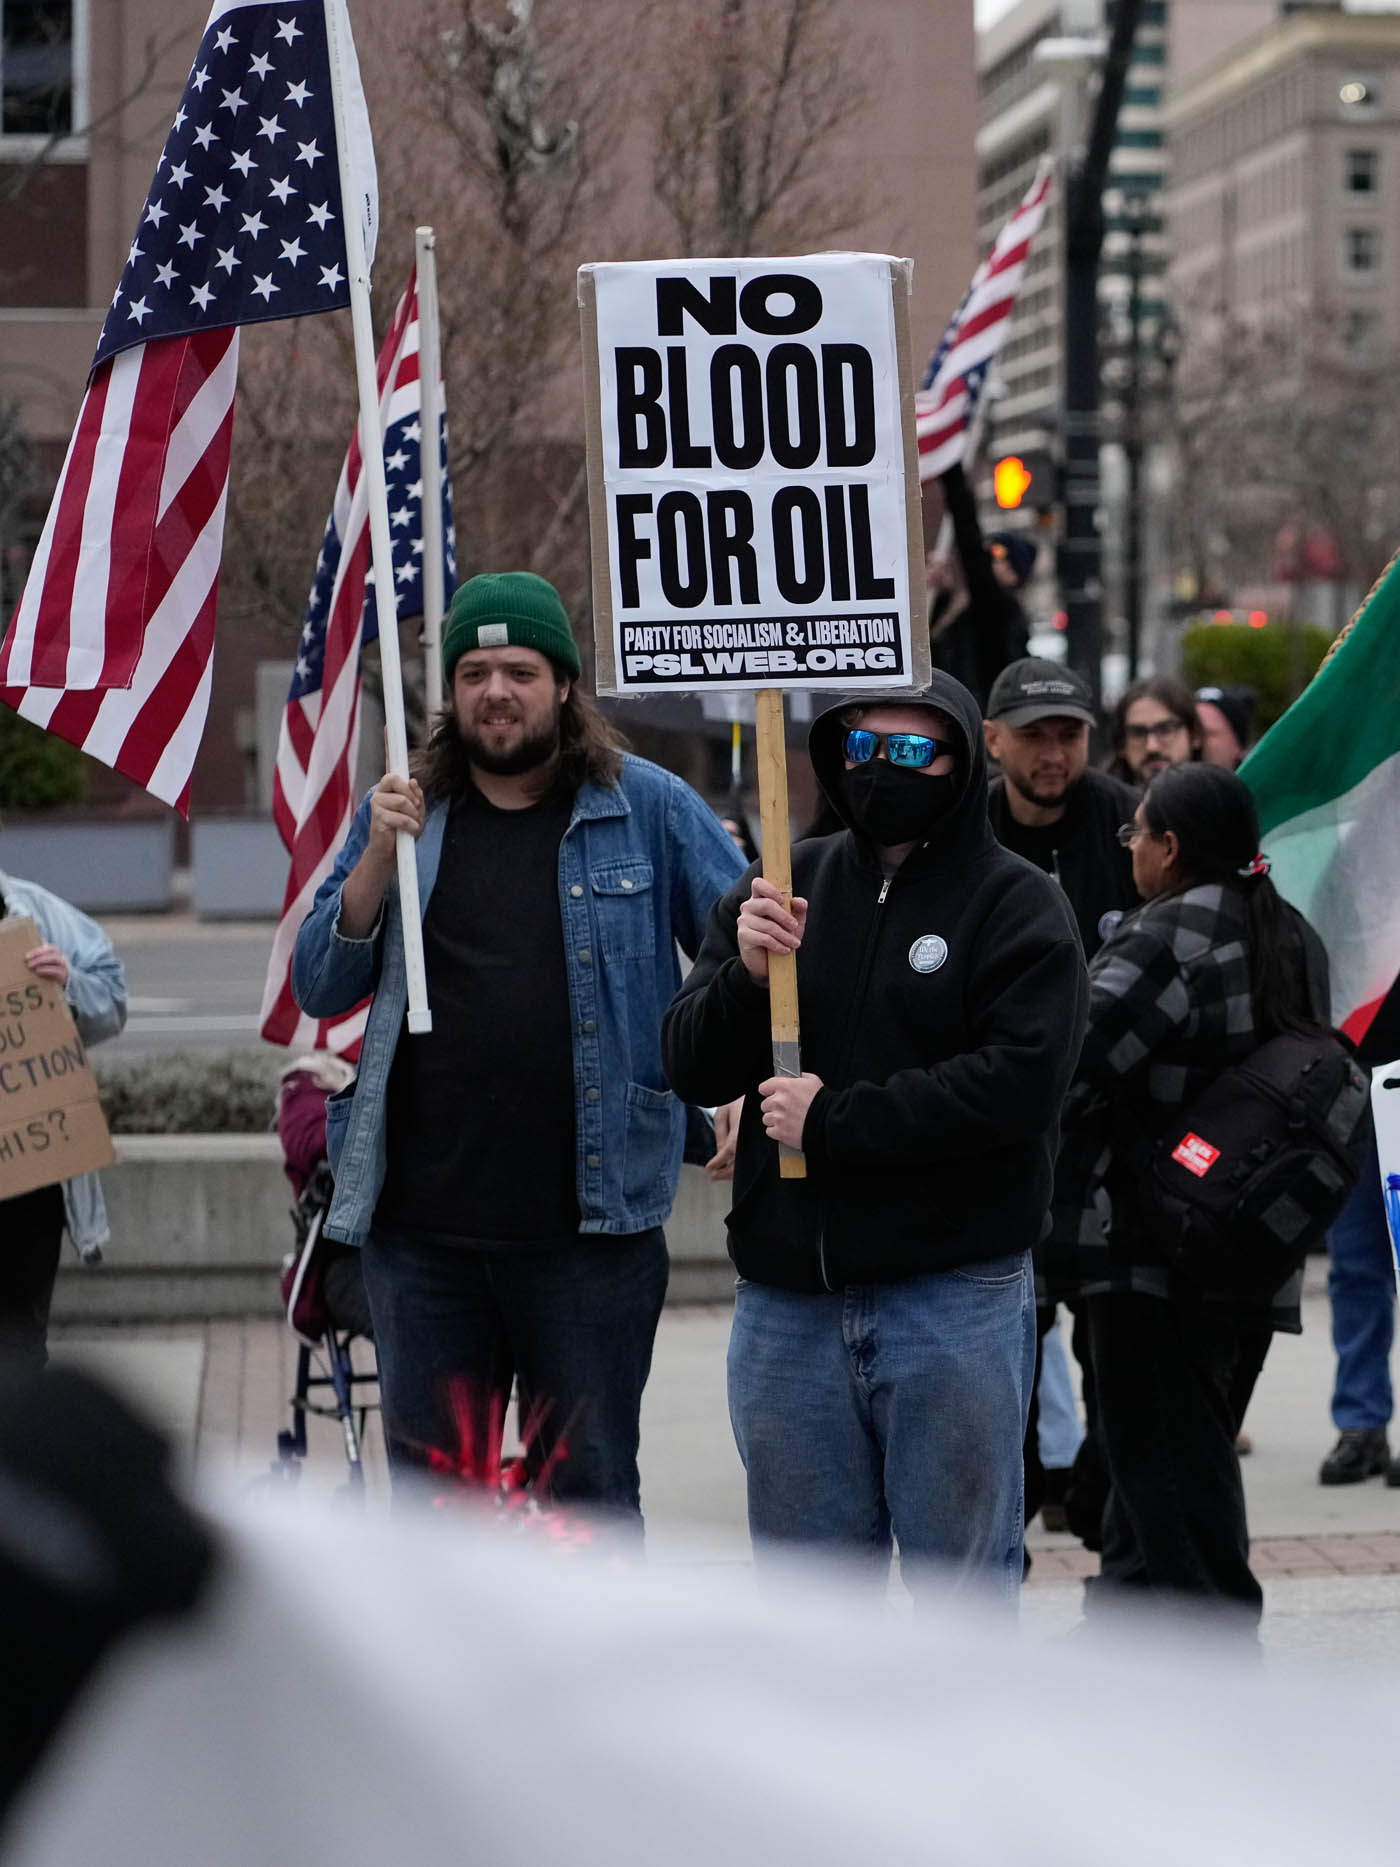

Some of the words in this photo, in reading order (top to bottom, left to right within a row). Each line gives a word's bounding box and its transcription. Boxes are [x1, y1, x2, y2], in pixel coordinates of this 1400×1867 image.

[655, 274, 823, 336] NO
[615, 342, 877, 470] BLOOD
[615, 489, 761, 609] FOR
[771, 484, 895, 605] OIL
[624, 626, 673, 651] PARTY
[673, 625, 701, 650] FOR
[703, 622, 784, 649] SOCIALISM
[785, 622, 806, 646] &
[806, 618, 895, 645] LIBERATION
[625, 646, 897, 677] PSLWEB.ORG
